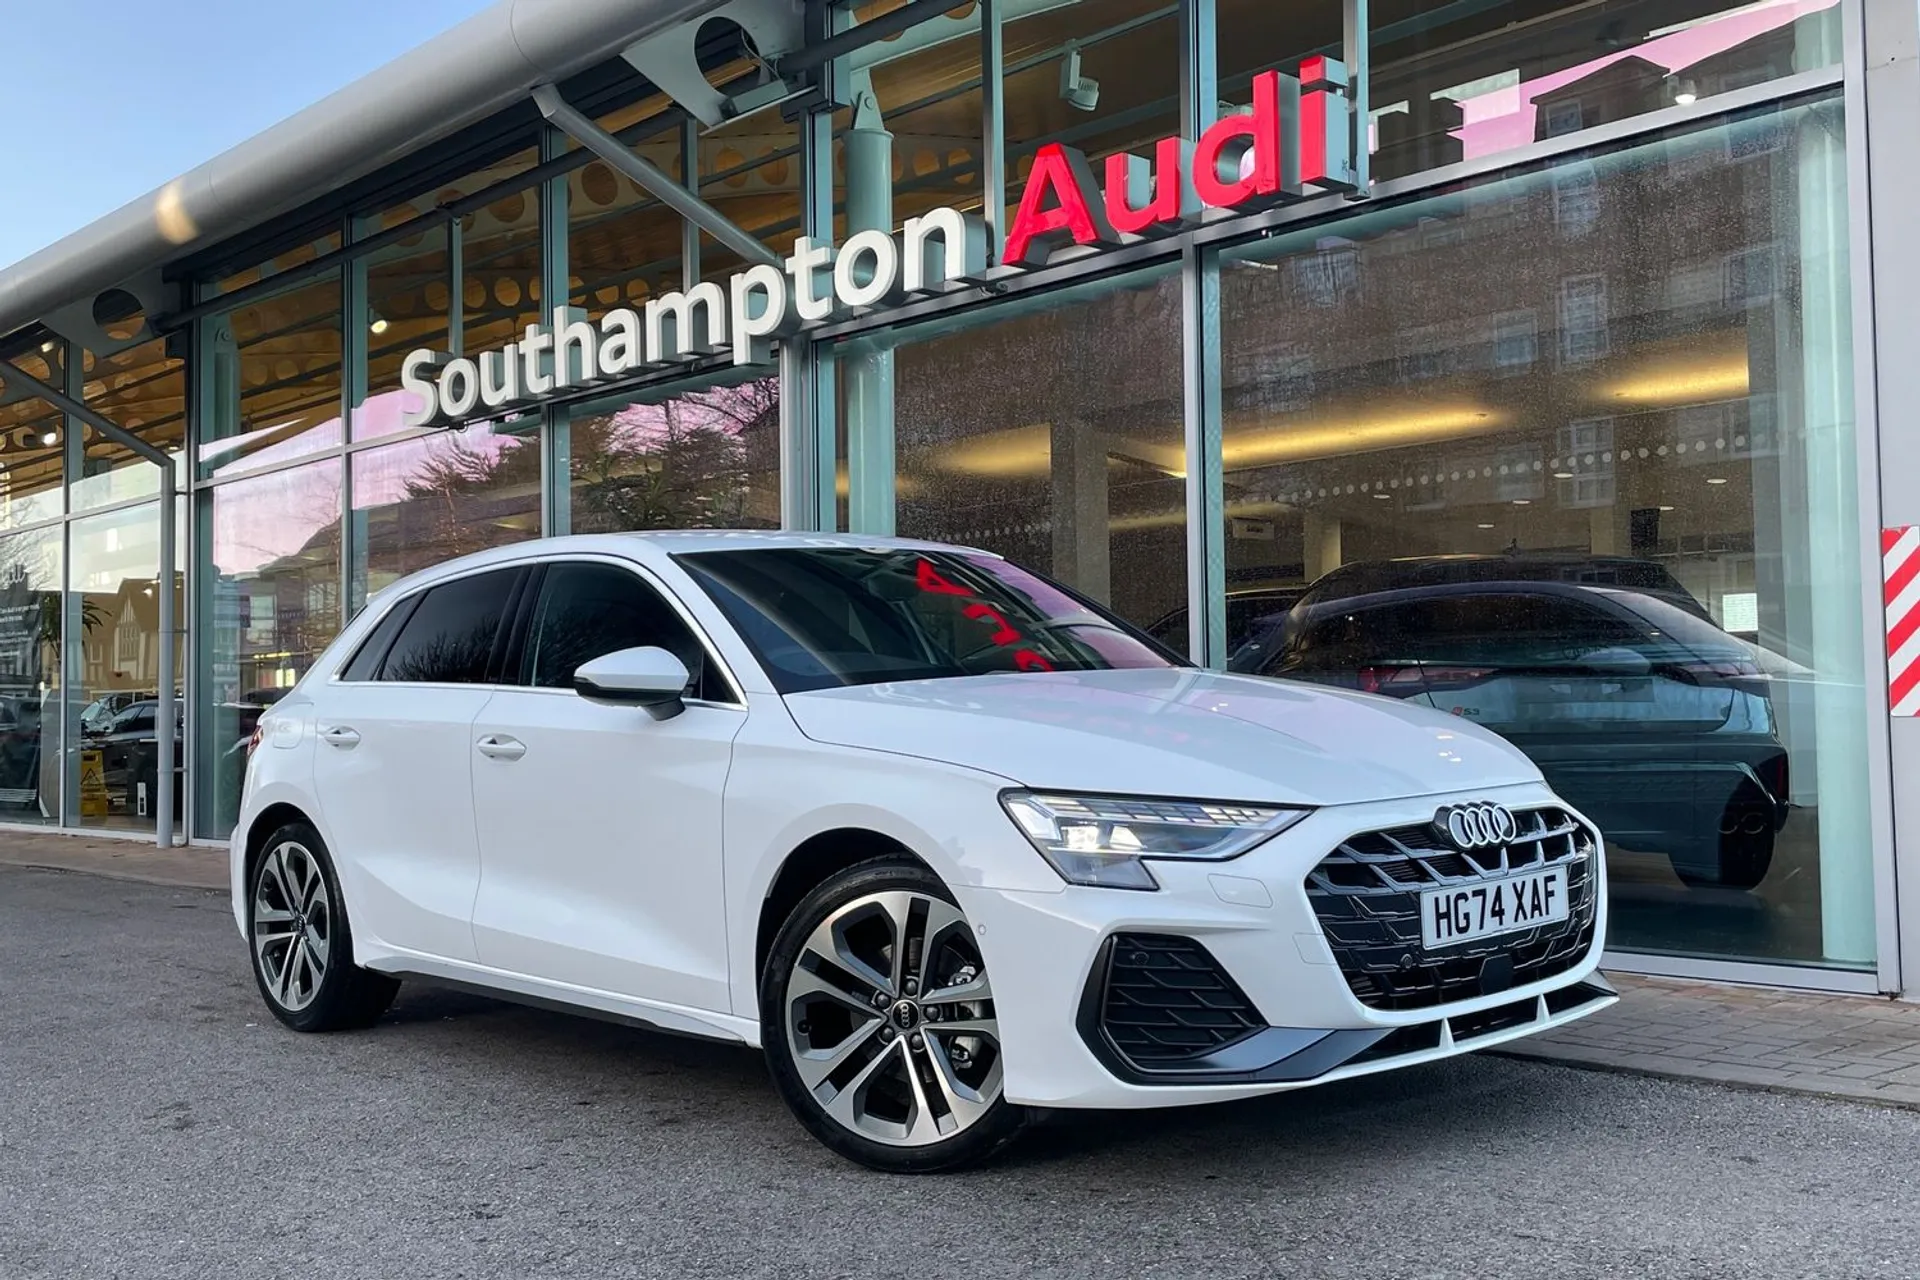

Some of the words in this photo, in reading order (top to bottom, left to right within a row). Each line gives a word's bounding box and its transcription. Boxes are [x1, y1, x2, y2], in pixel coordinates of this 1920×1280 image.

[401, 206, 968, 427] Southampton
[1001, 53, 1330, 266] Audi
[1434, 884, 1506, 939] HG74
[1512, 874, 1557, 923] XAF
